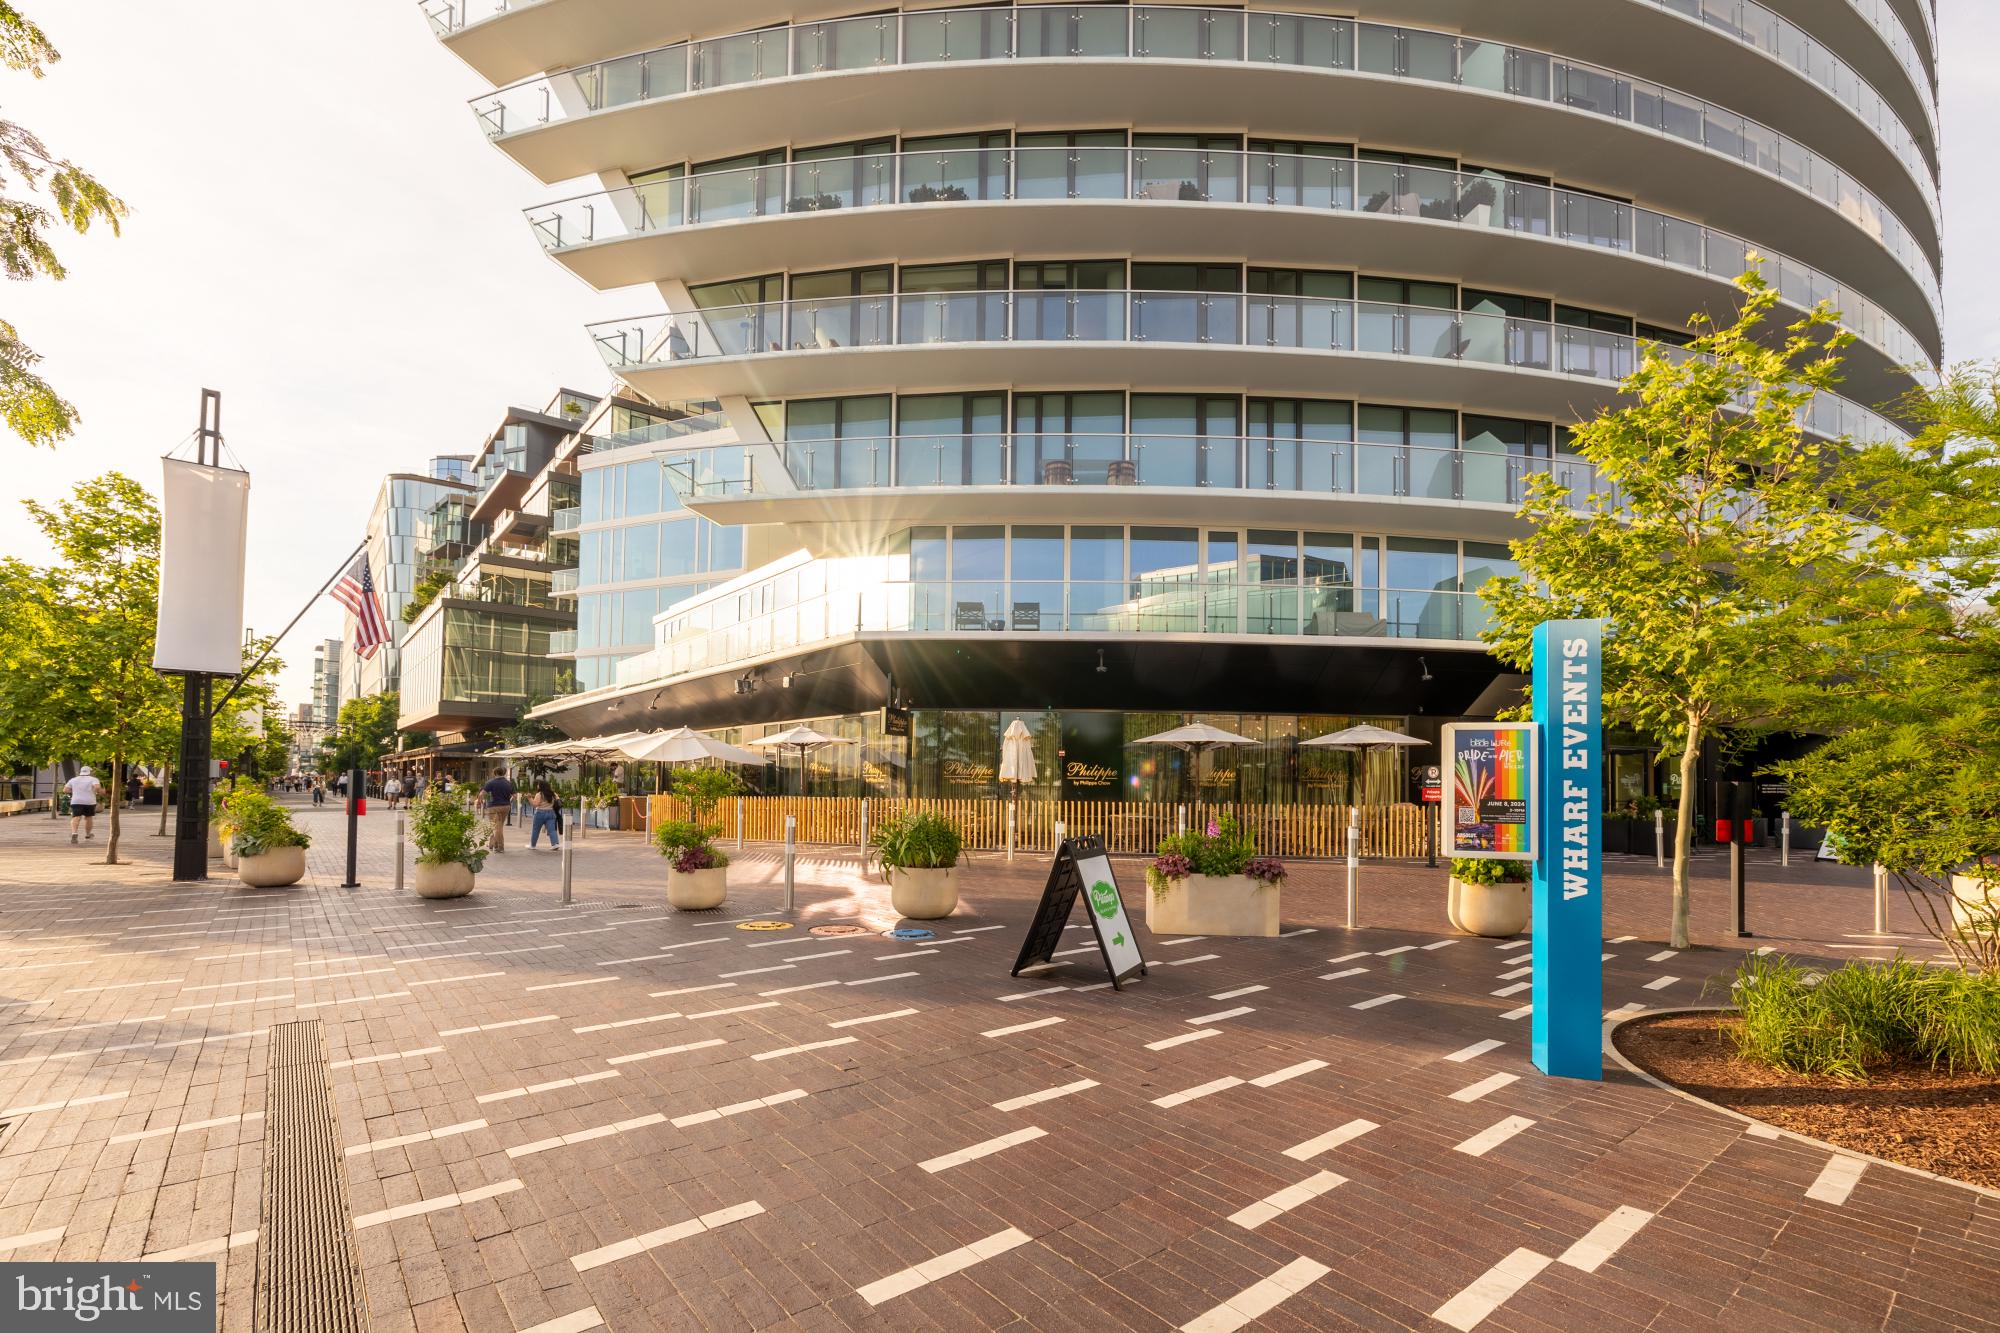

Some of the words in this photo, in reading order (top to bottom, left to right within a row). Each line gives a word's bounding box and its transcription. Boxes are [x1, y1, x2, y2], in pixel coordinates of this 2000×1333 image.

[1563, 638, 1588, 769] EVENTS
[1458, 749, 1489, 762] PRIDE
[1499, 749, 1524, 764] PIER
[943, 761, 994, 778] Philippe
[1067, 762, 1118, 781] Philippe
[1563, 779, 1588, 900] WHARF
